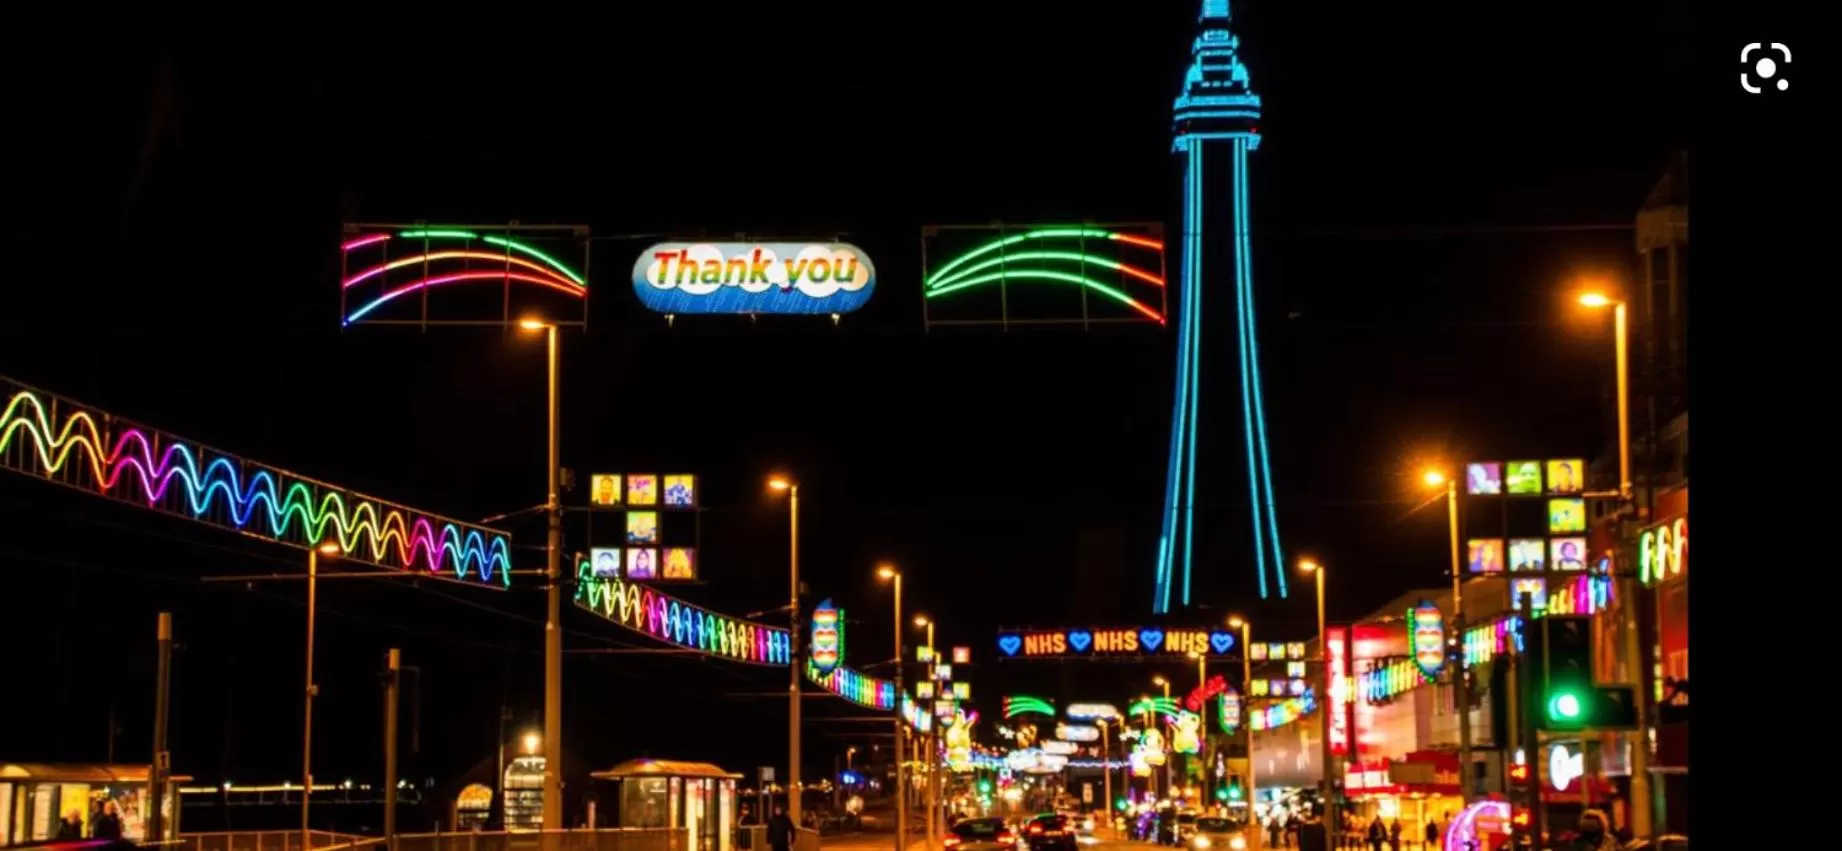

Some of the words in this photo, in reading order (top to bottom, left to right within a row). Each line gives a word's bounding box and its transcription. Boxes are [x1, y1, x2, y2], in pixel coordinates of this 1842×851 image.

[654, 247, 772, 285] Thank
[783, 256, 858, 293] you
[1024, 633, 1066, 654] NHS
[1094, 630, 1138, 651] NHS
[1165, 631, 1209, 653] NHS
